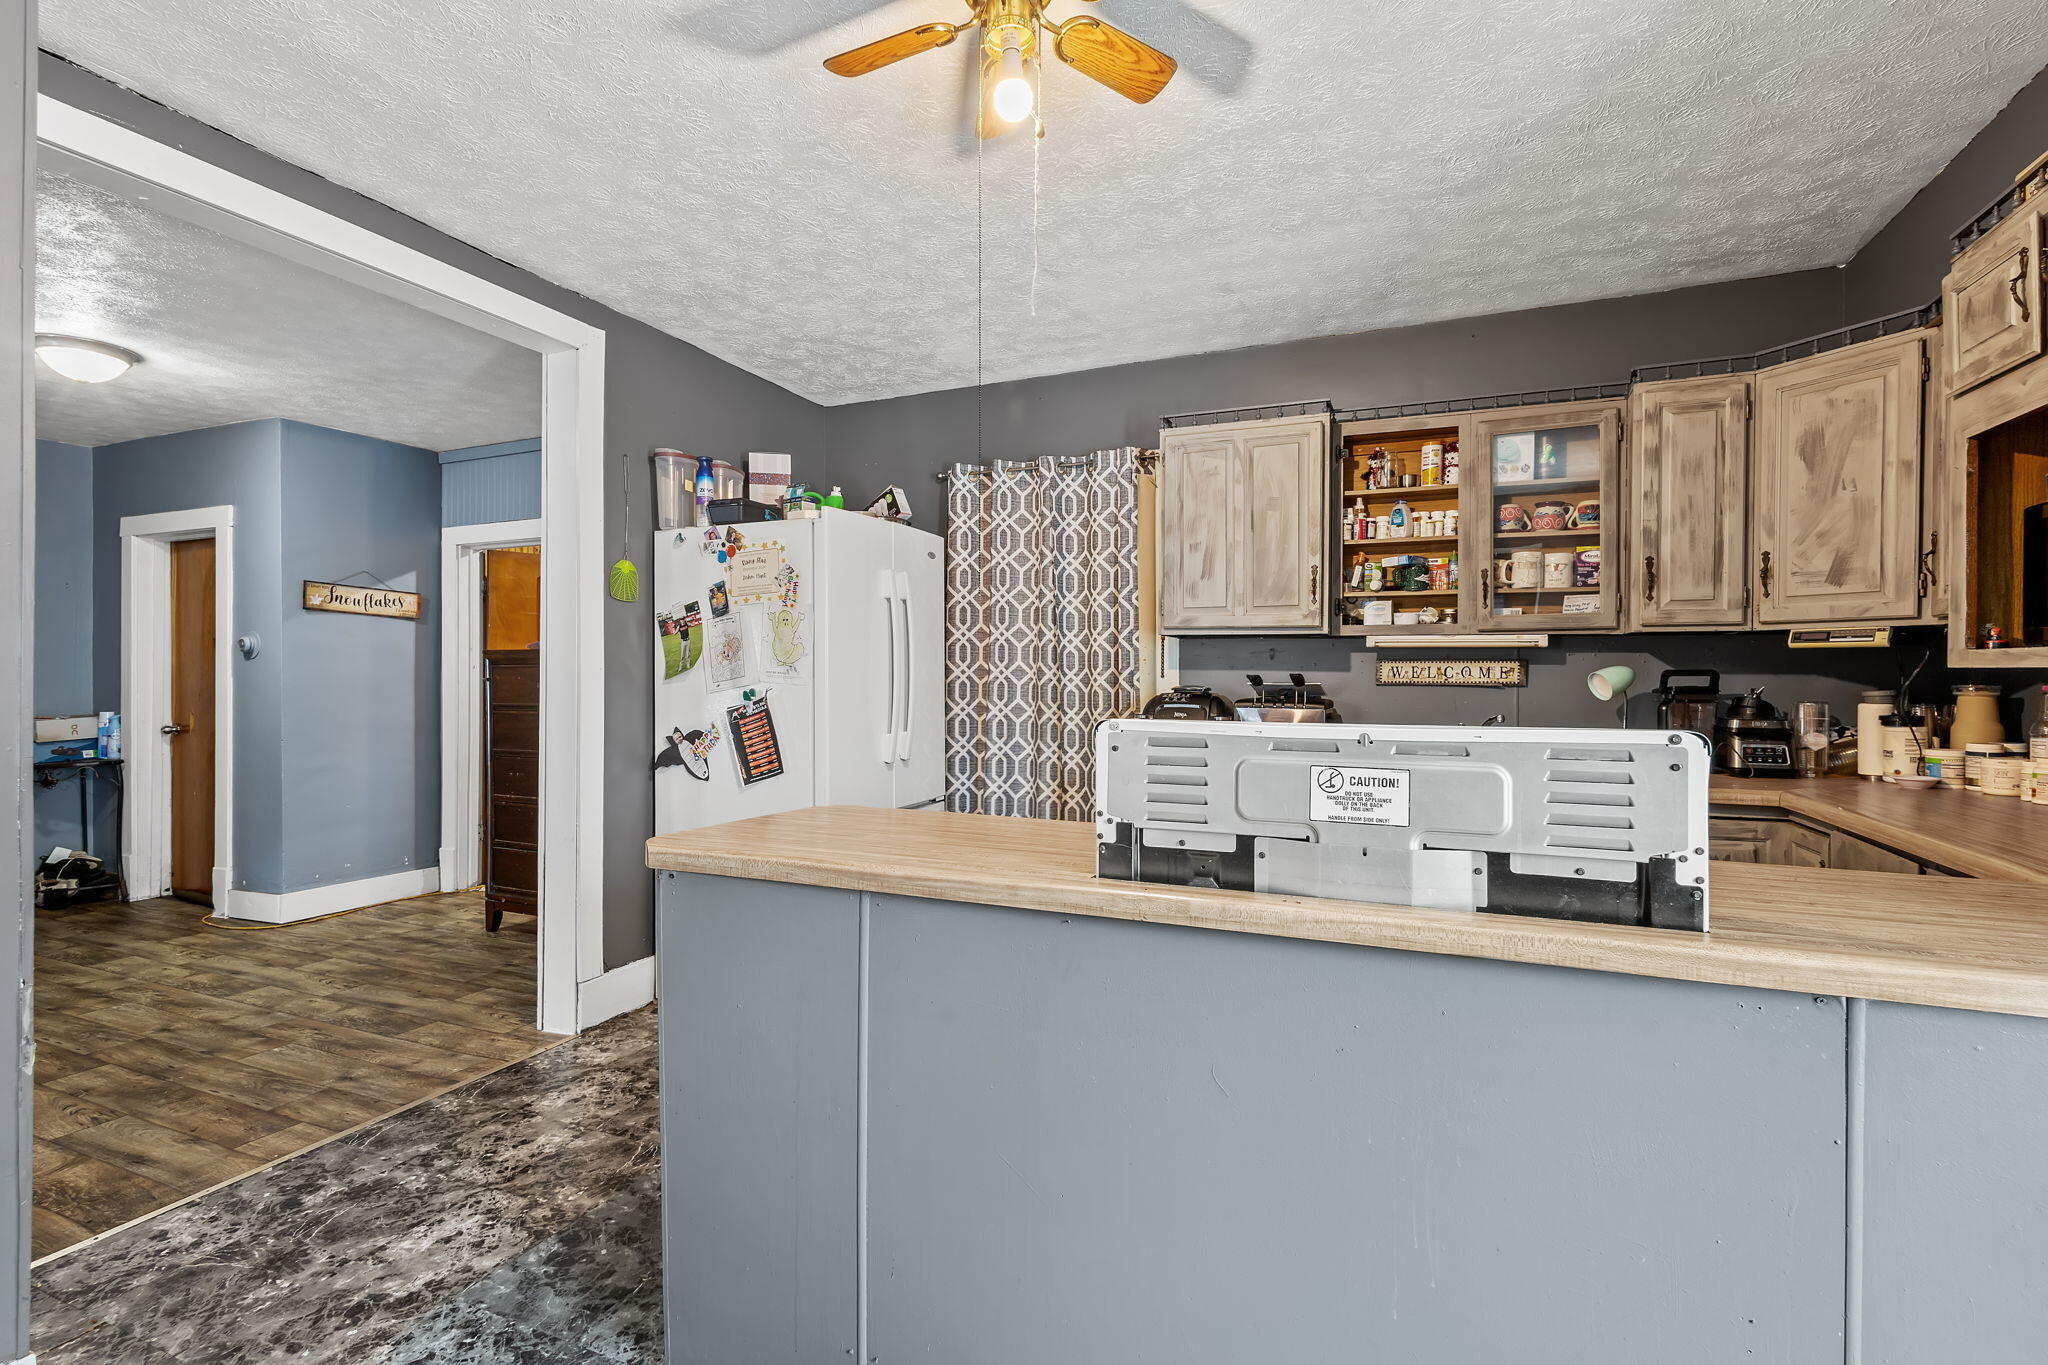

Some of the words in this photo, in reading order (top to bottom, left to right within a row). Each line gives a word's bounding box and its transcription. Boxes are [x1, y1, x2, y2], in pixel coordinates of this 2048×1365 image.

[323, 585, 404, 612] Snowflakes
[1390, 666, 1509, 679] WELCOME
[1349, 776, 1400, 788] CAUTION!
